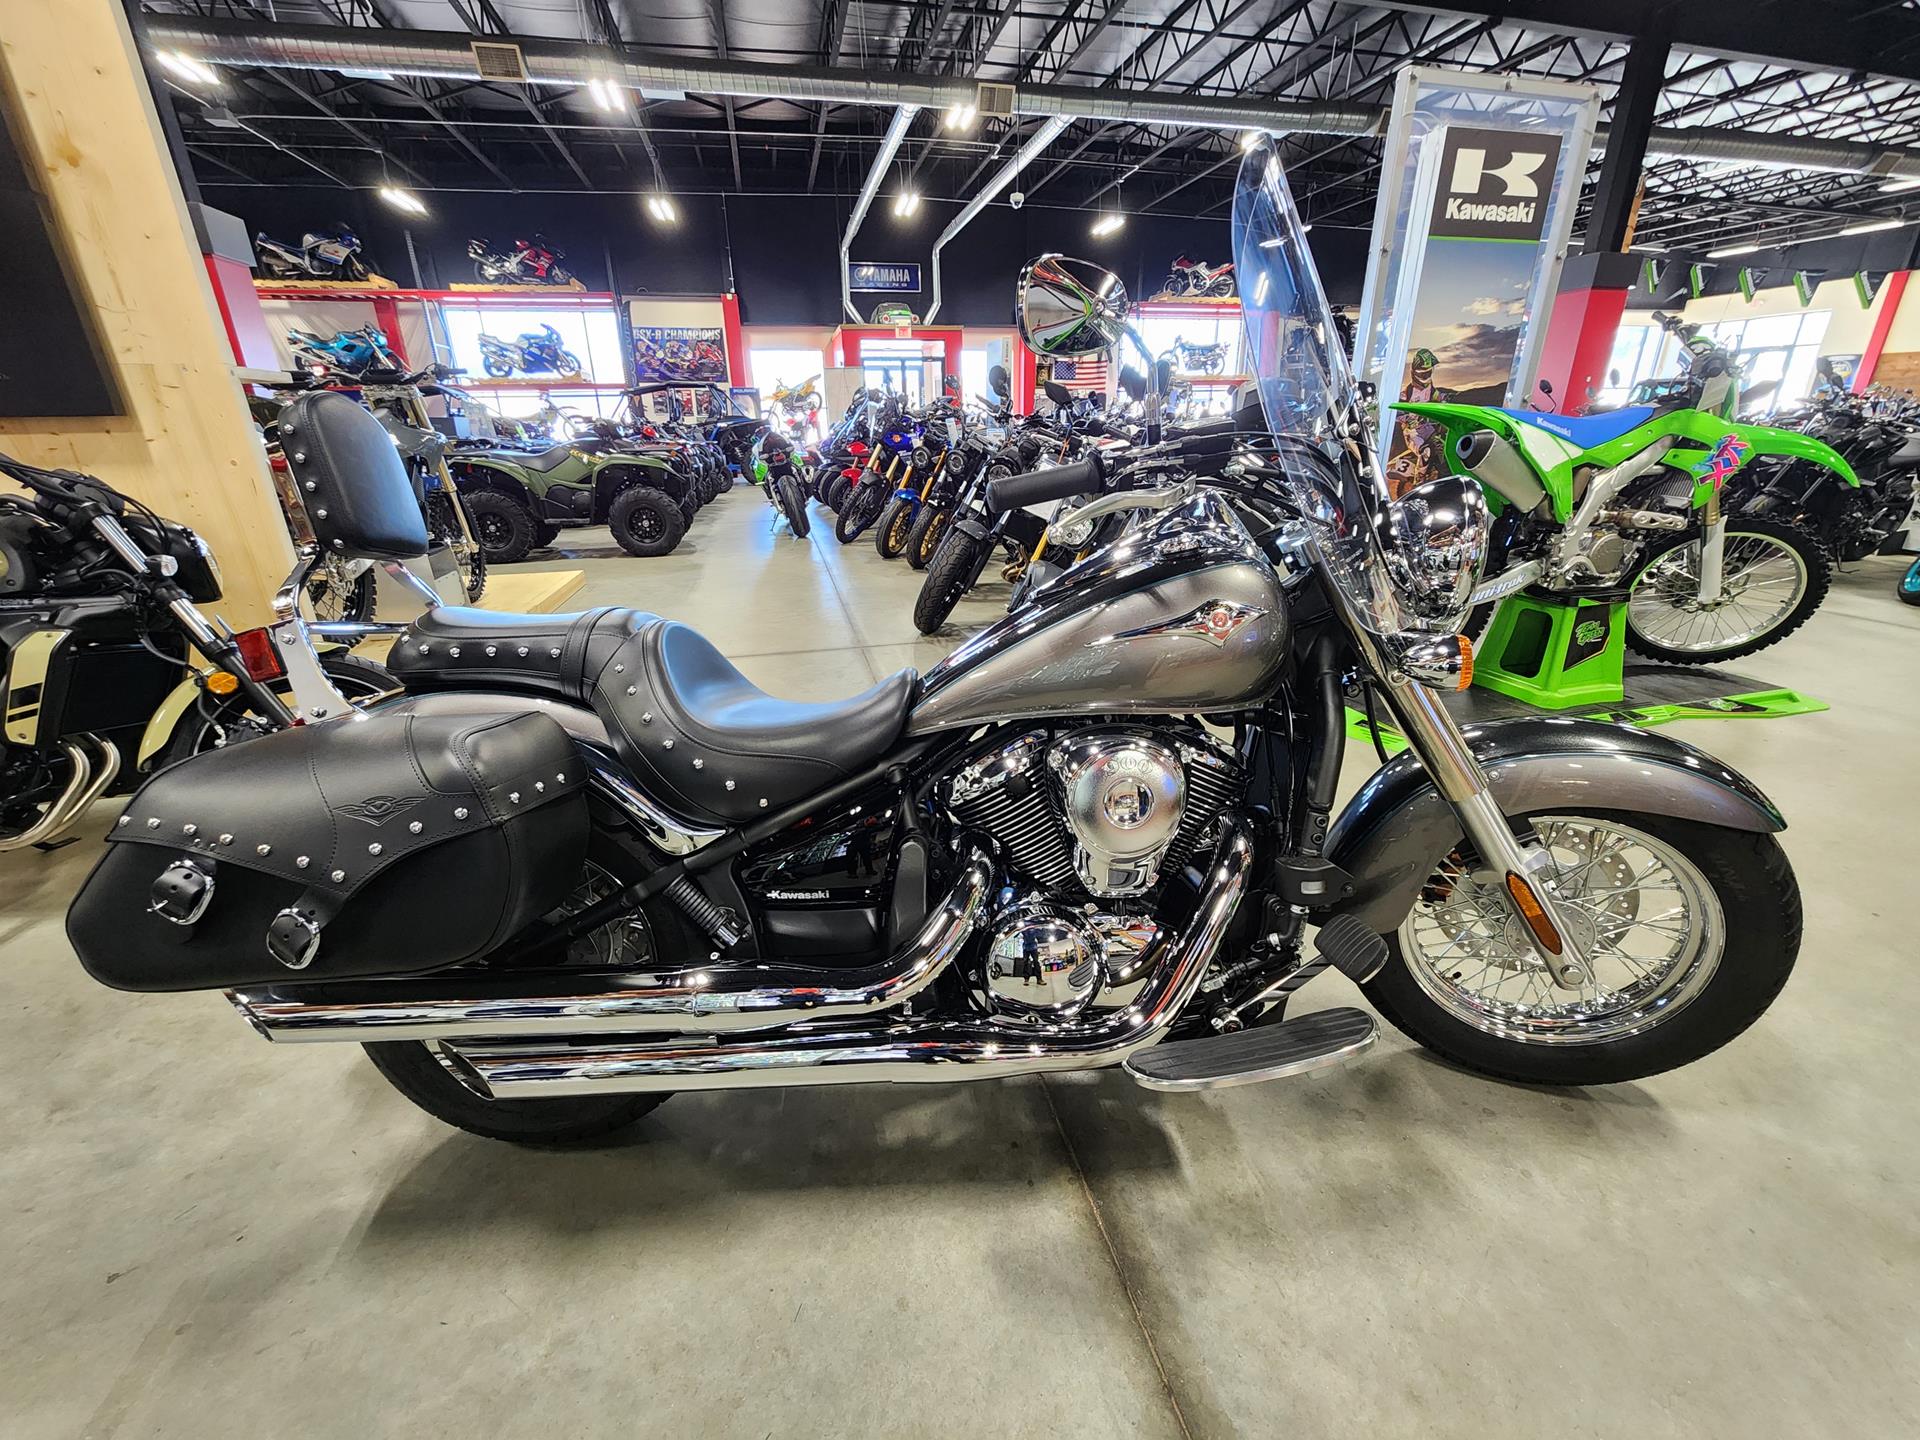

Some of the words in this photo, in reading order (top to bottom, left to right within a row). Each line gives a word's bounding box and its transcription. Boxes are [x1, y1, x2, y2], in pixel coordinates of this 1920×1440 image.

[1445, 198, 1536, 223] Kawasaki
[633, 329, 662, 340] GSX-R
[665, 328, 721, 340] CHAMPIONS
[1397, 460, 1410, 473] 3
[766, 889, 830, 900] Kawasaki
